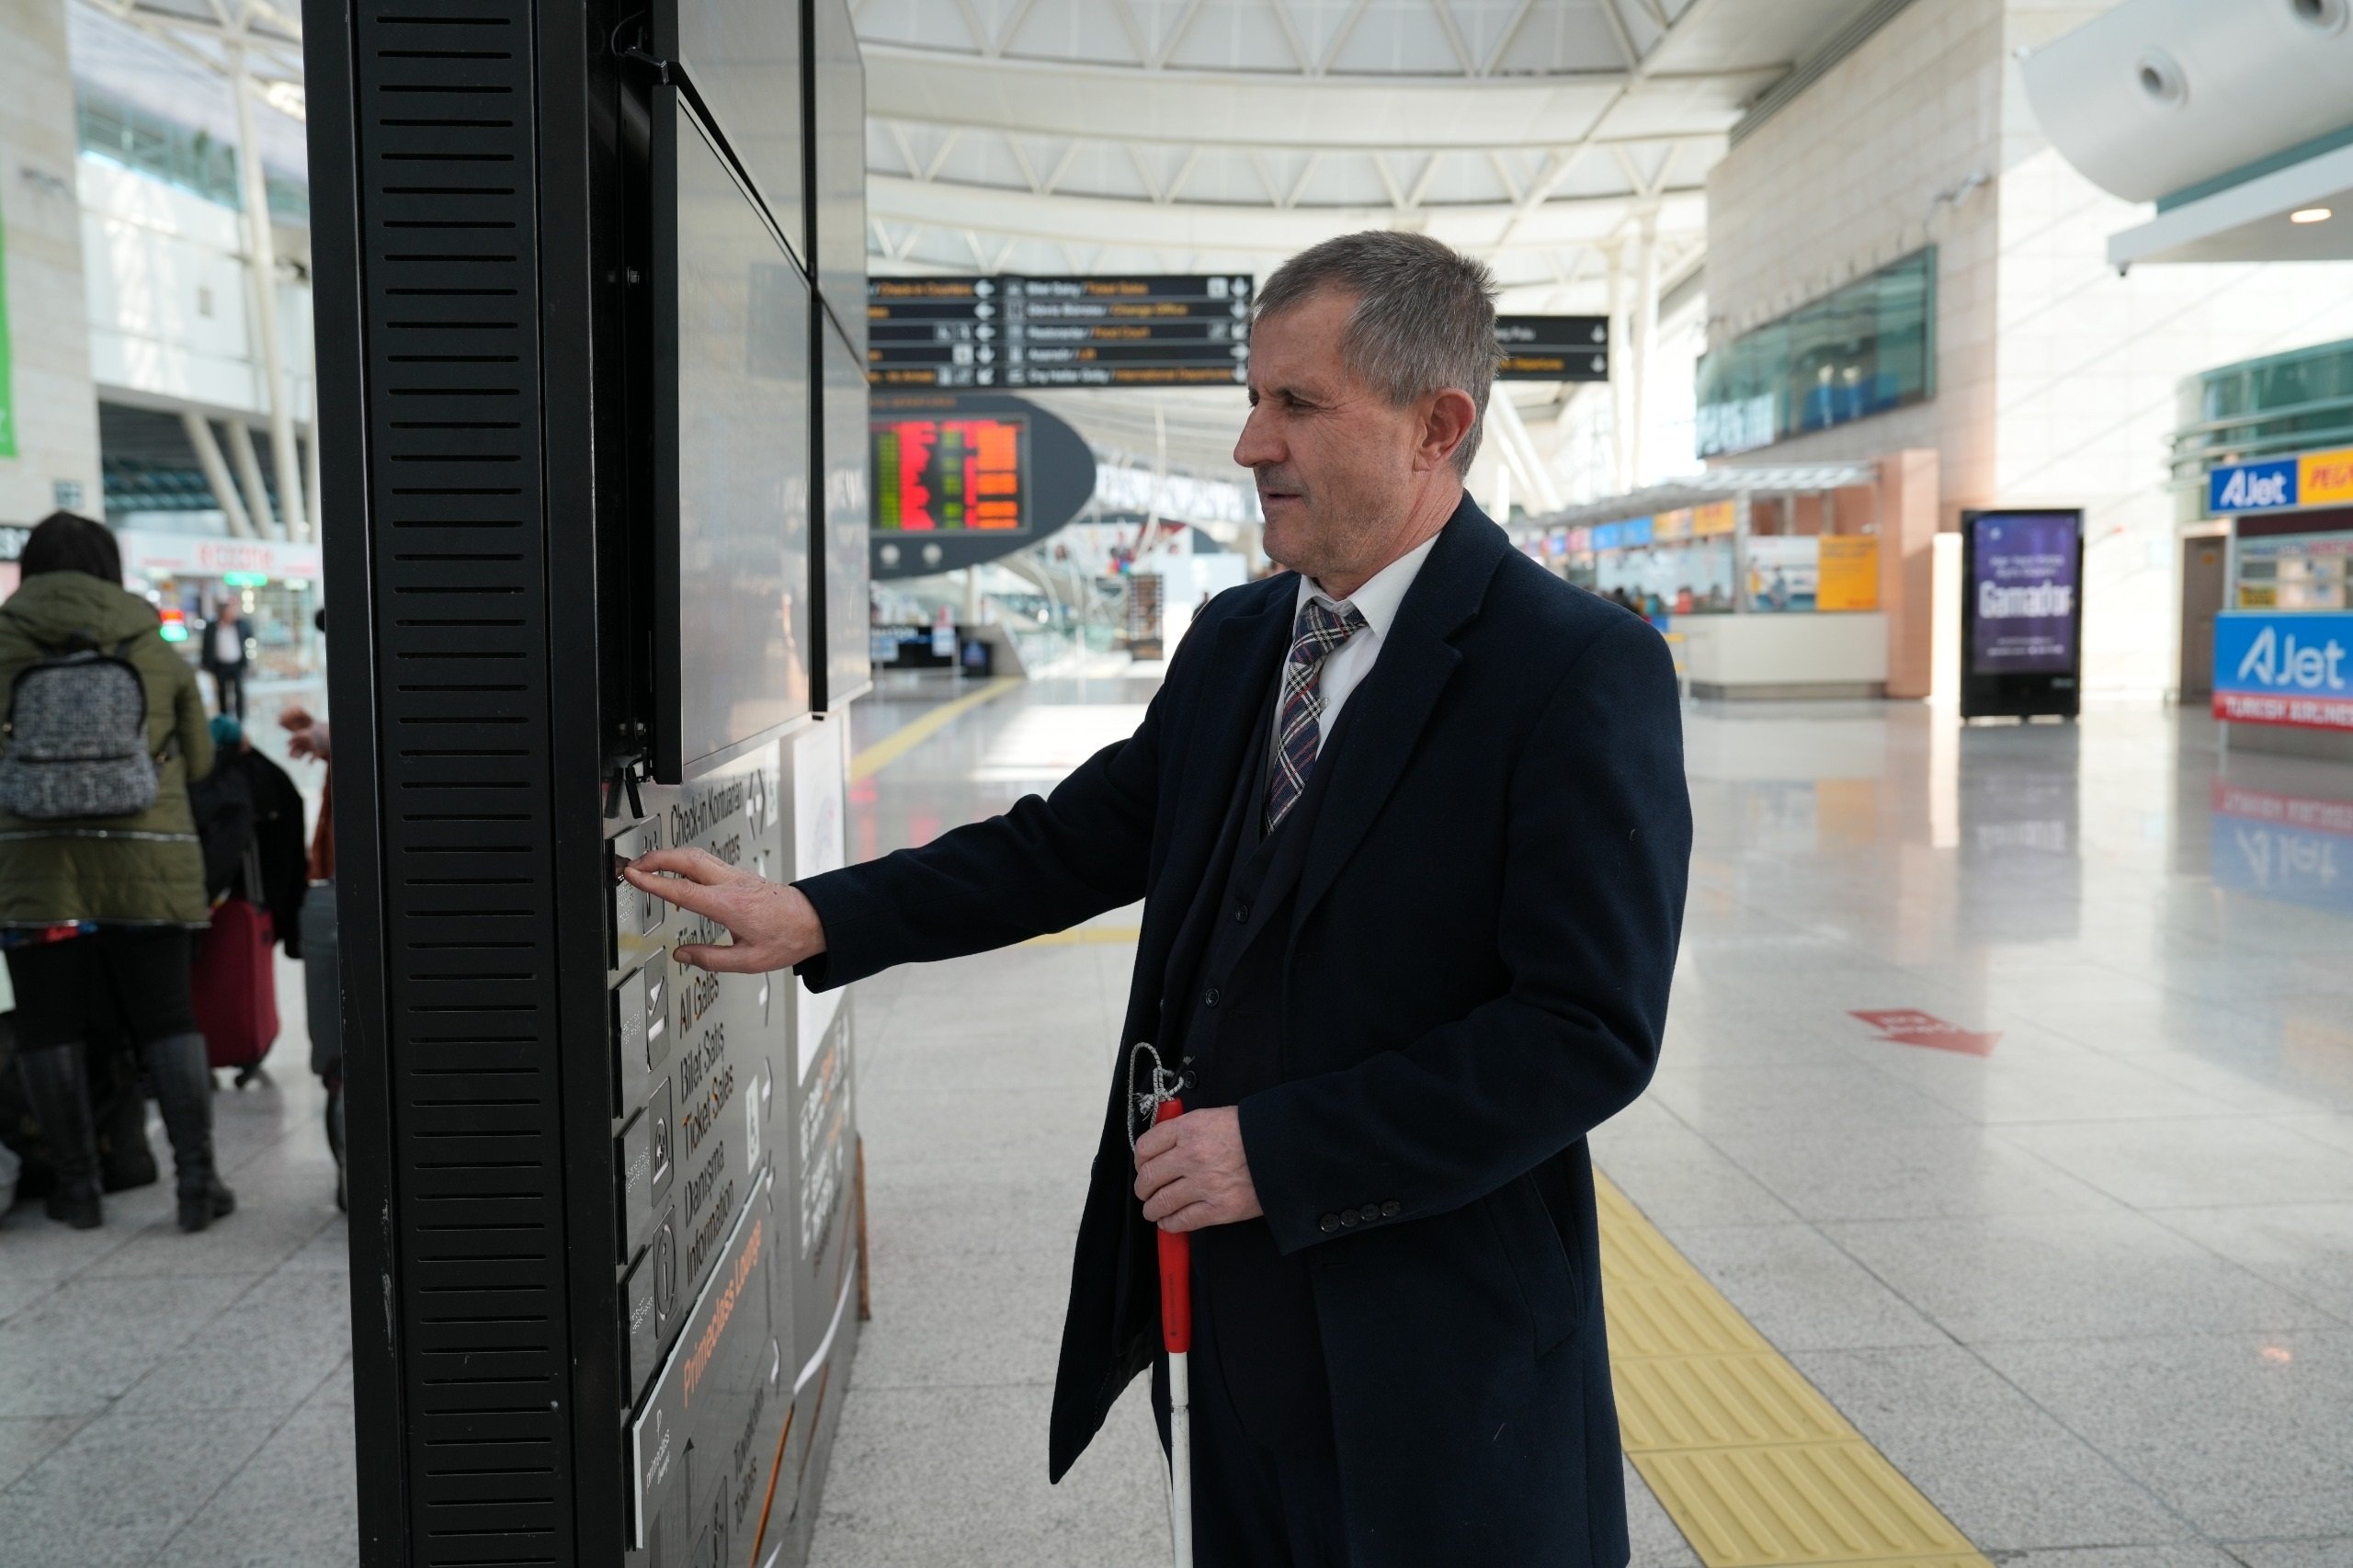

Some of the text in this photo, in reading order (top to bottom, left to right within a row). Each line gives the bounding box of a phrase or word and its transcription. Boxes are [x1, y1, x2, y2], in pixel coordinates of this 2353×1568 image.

[2308, 461, 2353, 492] PEG
[2238, 627, 2346, 689] AJet
[671, 795, 708, 848] Check-in
[680, 971, 720, 1040] All Gates
[680, 1043, 702, 1104] Bilet
[682, 1064, 734, 1161] Ticket Sales
[685, 1140, 724, 1229] Danışma
[687, 1179, 734, 1288] Information
[684, 1279, 734, 1410] Primeclass
